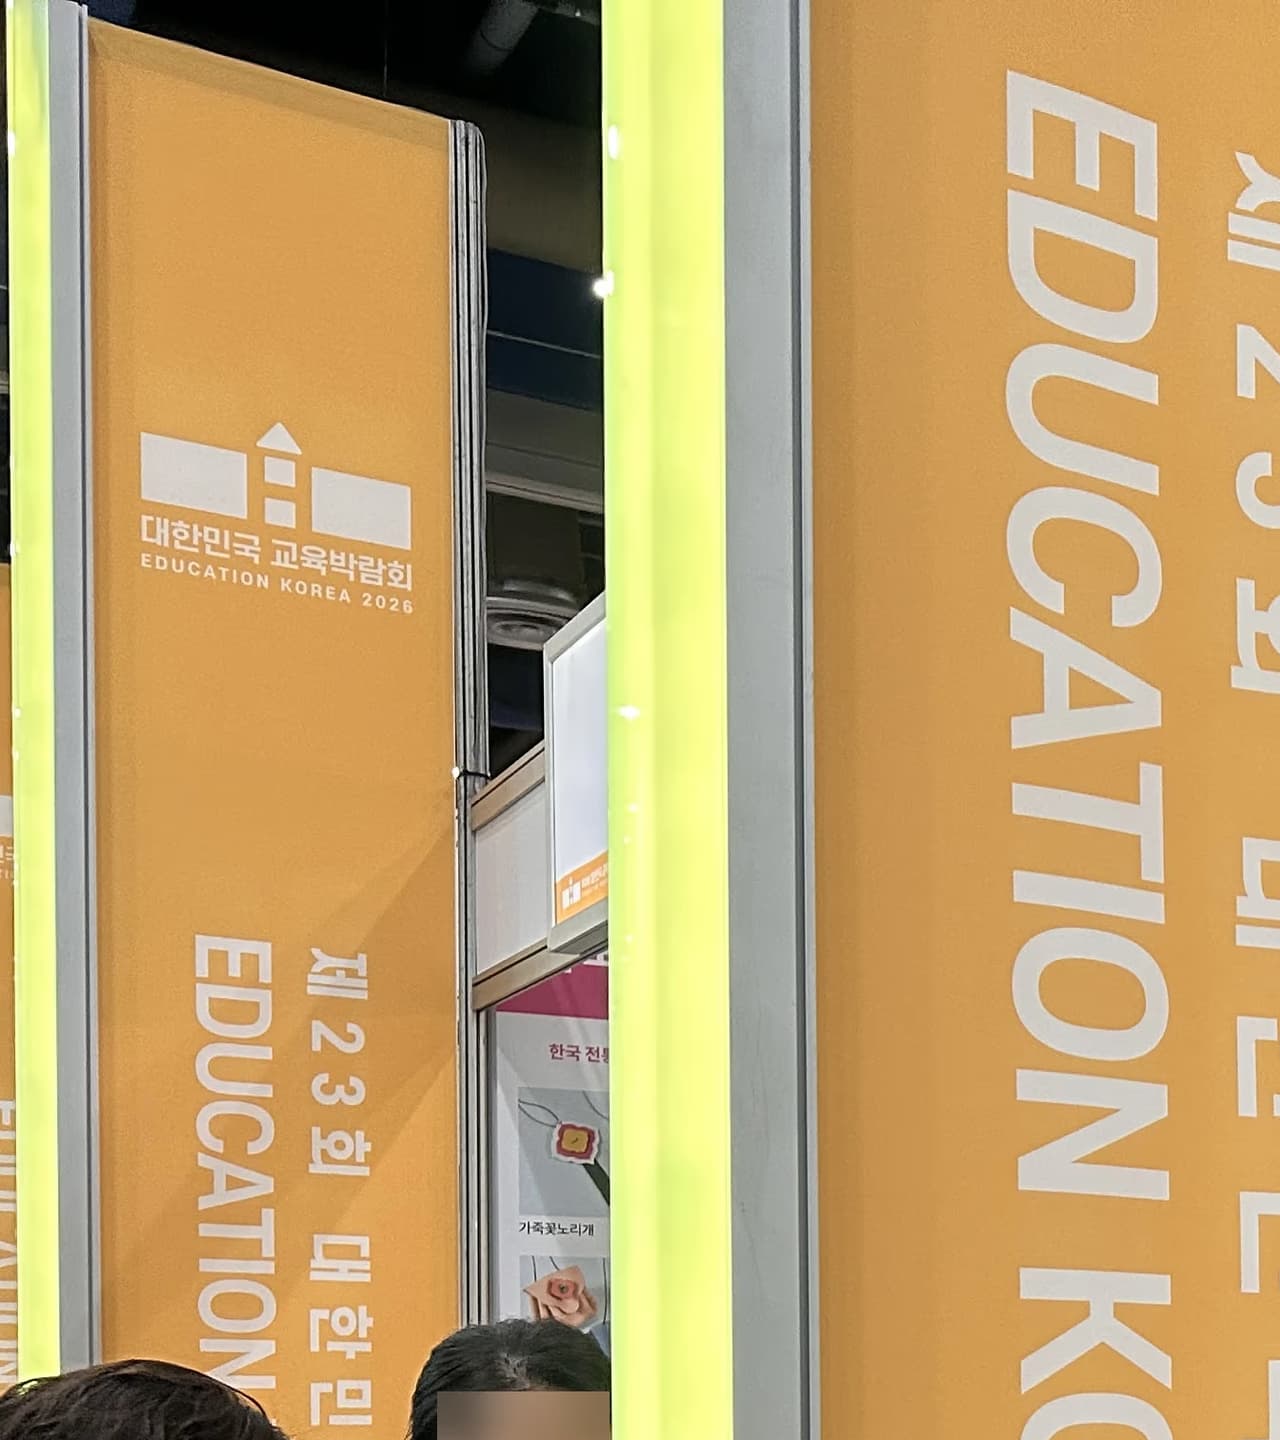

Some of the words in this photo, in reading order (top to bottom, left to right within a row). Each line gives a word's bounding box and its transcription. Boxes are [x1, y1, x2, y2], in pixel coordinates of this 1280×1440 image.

[140, 515, 261, 566] 대한민국
[270, 538, 413, 592] 교육박람회
[141, 554, 269, 590] EDUCATION
[280, 578, 351, 604] KOREA
[362, 592, 414, 614] 2026
[1006, 69, 1170, 1201] EDUCATION
[306, 947, 371, 1176] 제23회
[549, 1043, 581, 1062] 한국
[194, 934, 277, 1390] EDUCATION
[518, 1220, 595, 1239] 가죽꽃노리개
